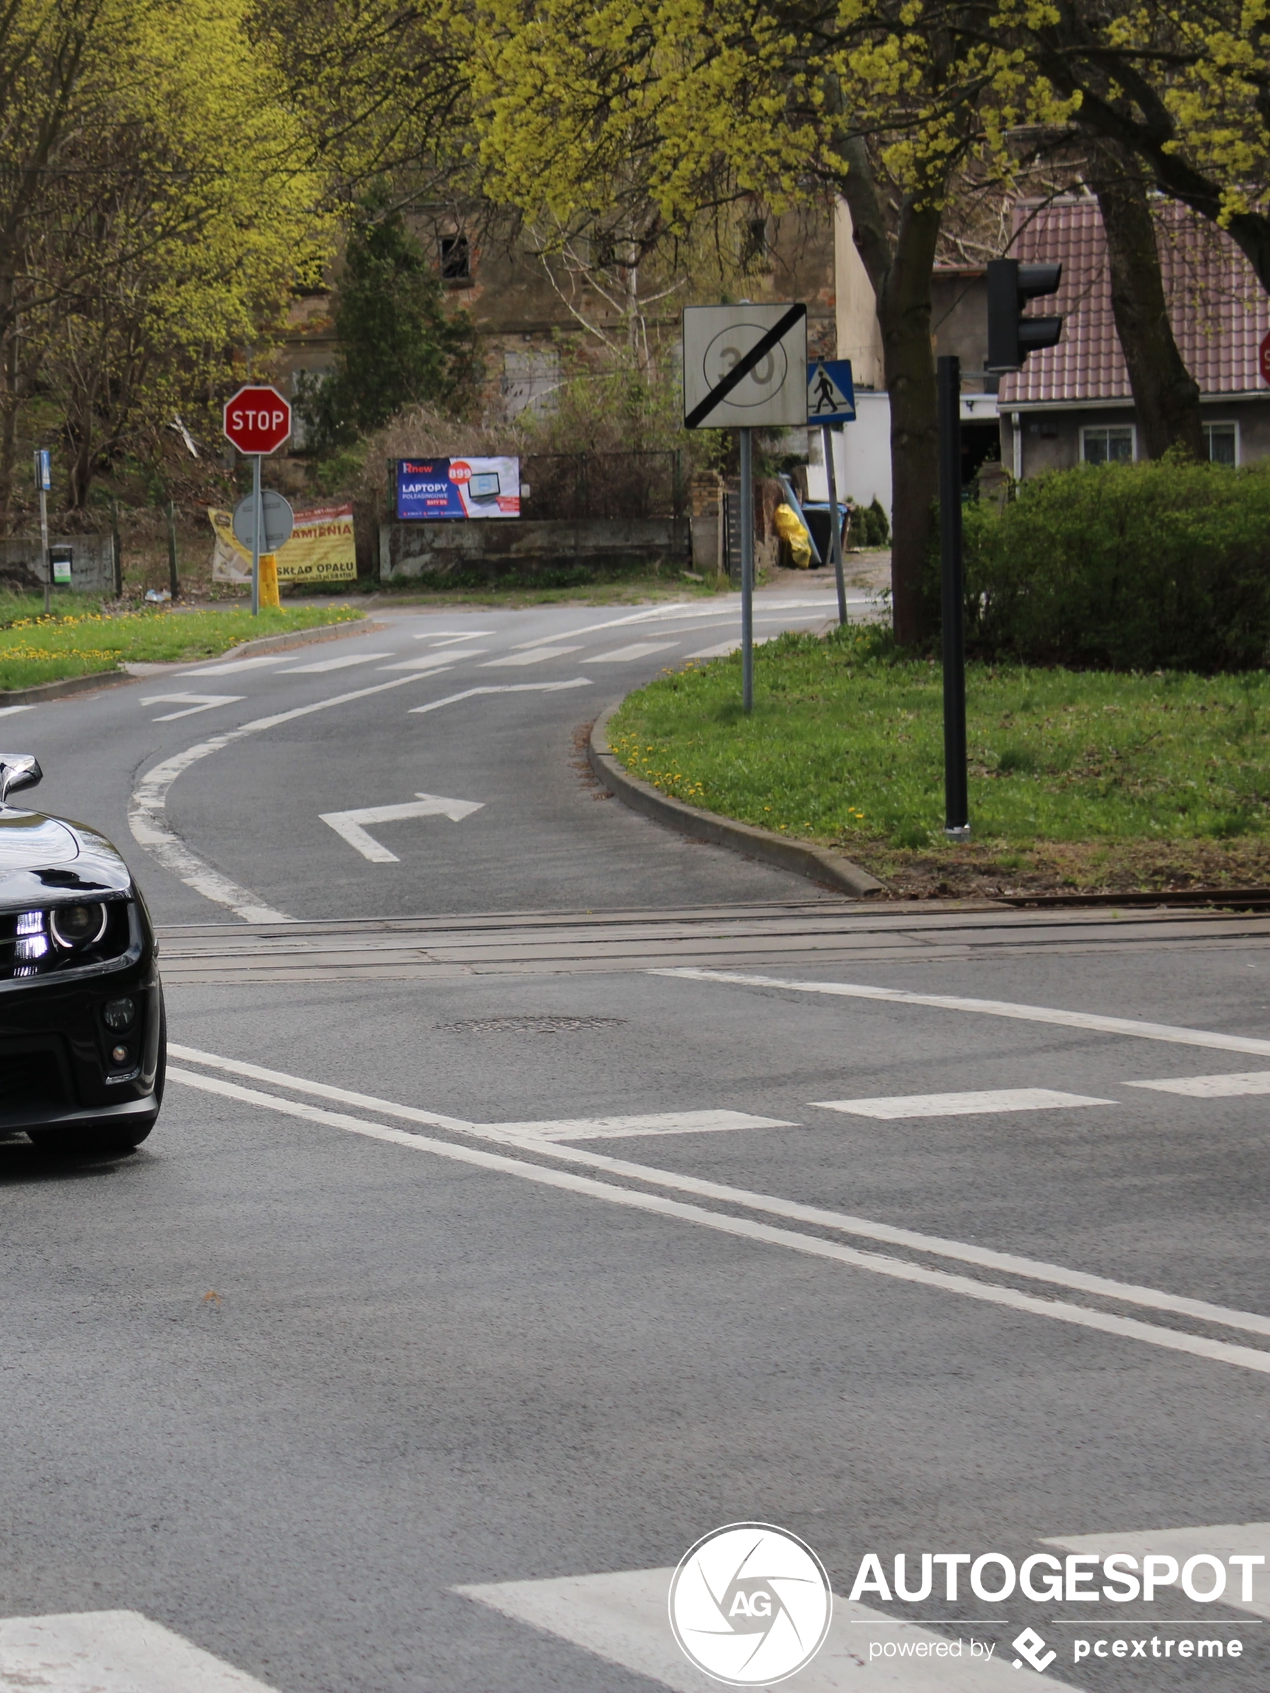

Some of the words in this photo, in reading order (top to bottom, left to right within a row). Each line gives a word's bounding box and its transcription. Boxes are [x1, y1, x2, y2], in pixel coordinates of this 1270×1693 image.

[232, 410, 284, 431] STOP
[449, 468, 471, 479] 899
[402, 483, 448, 493] LAPTOPY
[289, 524, 352, 540] AMIENIA
[277, 565, 313, 576] SKŁAD
[317, 562, 354, 573] OPAŁU
